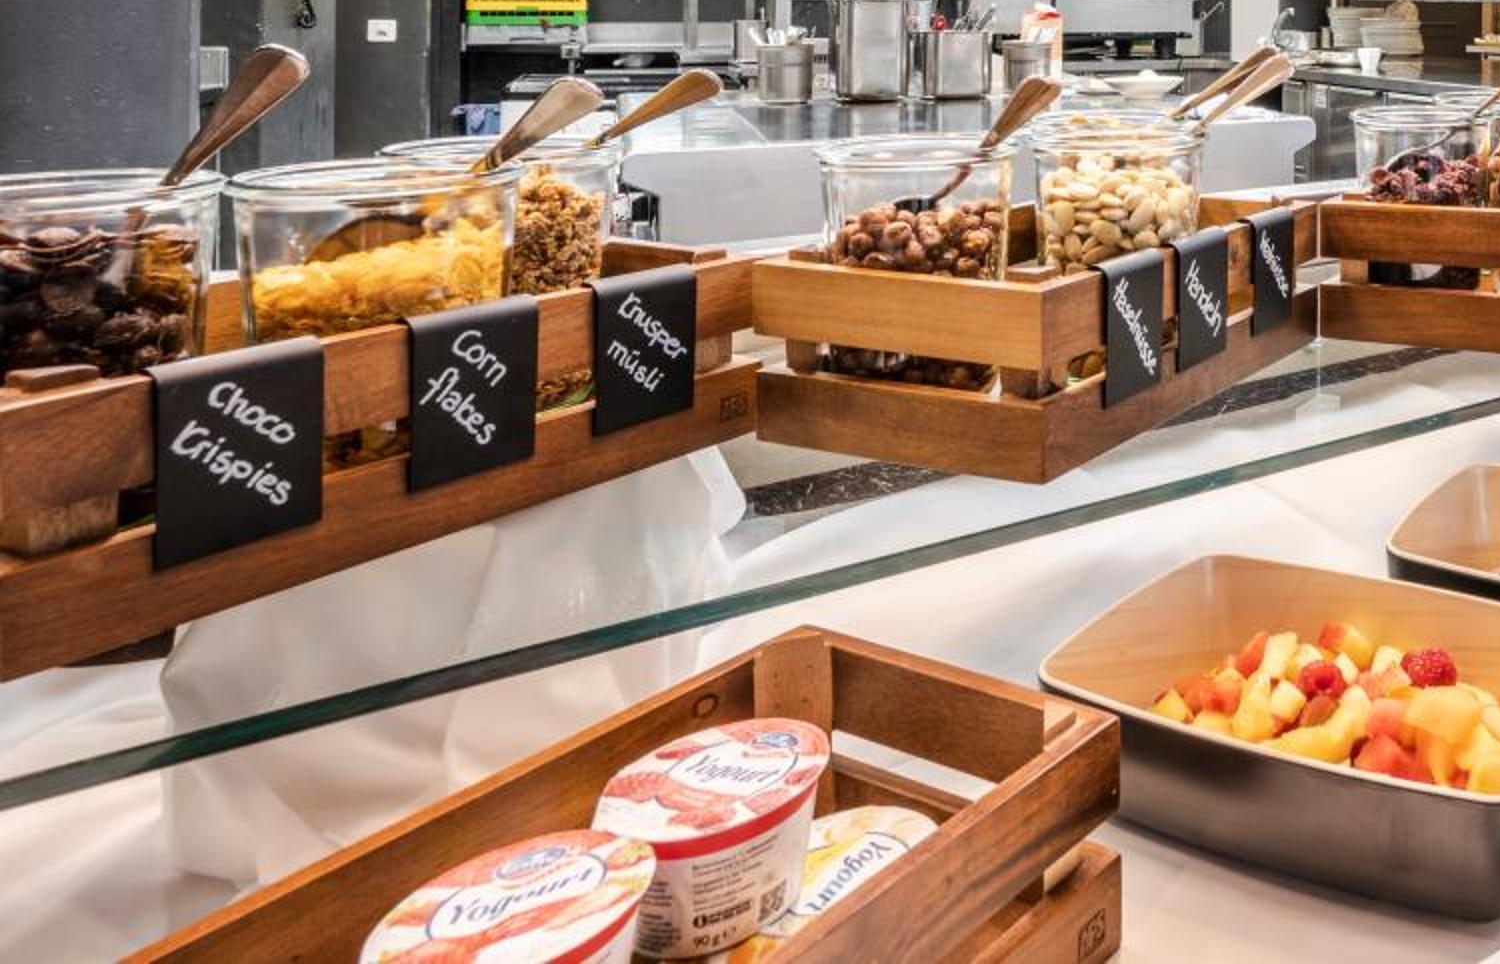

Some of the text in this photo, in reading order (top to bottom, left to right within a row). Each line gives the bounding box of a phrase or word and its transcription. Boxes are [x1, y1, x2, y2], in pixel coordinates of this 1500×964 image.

[451, 329, 508, 388] Corn
[617, 291, 688, 359] Knusper
[207, 381, 296, 444] Choco
[419, 366, 497, 445] flakes
[170, 419, 292, 506] Krispies
[806, 840, 893, 913] Yogourt
